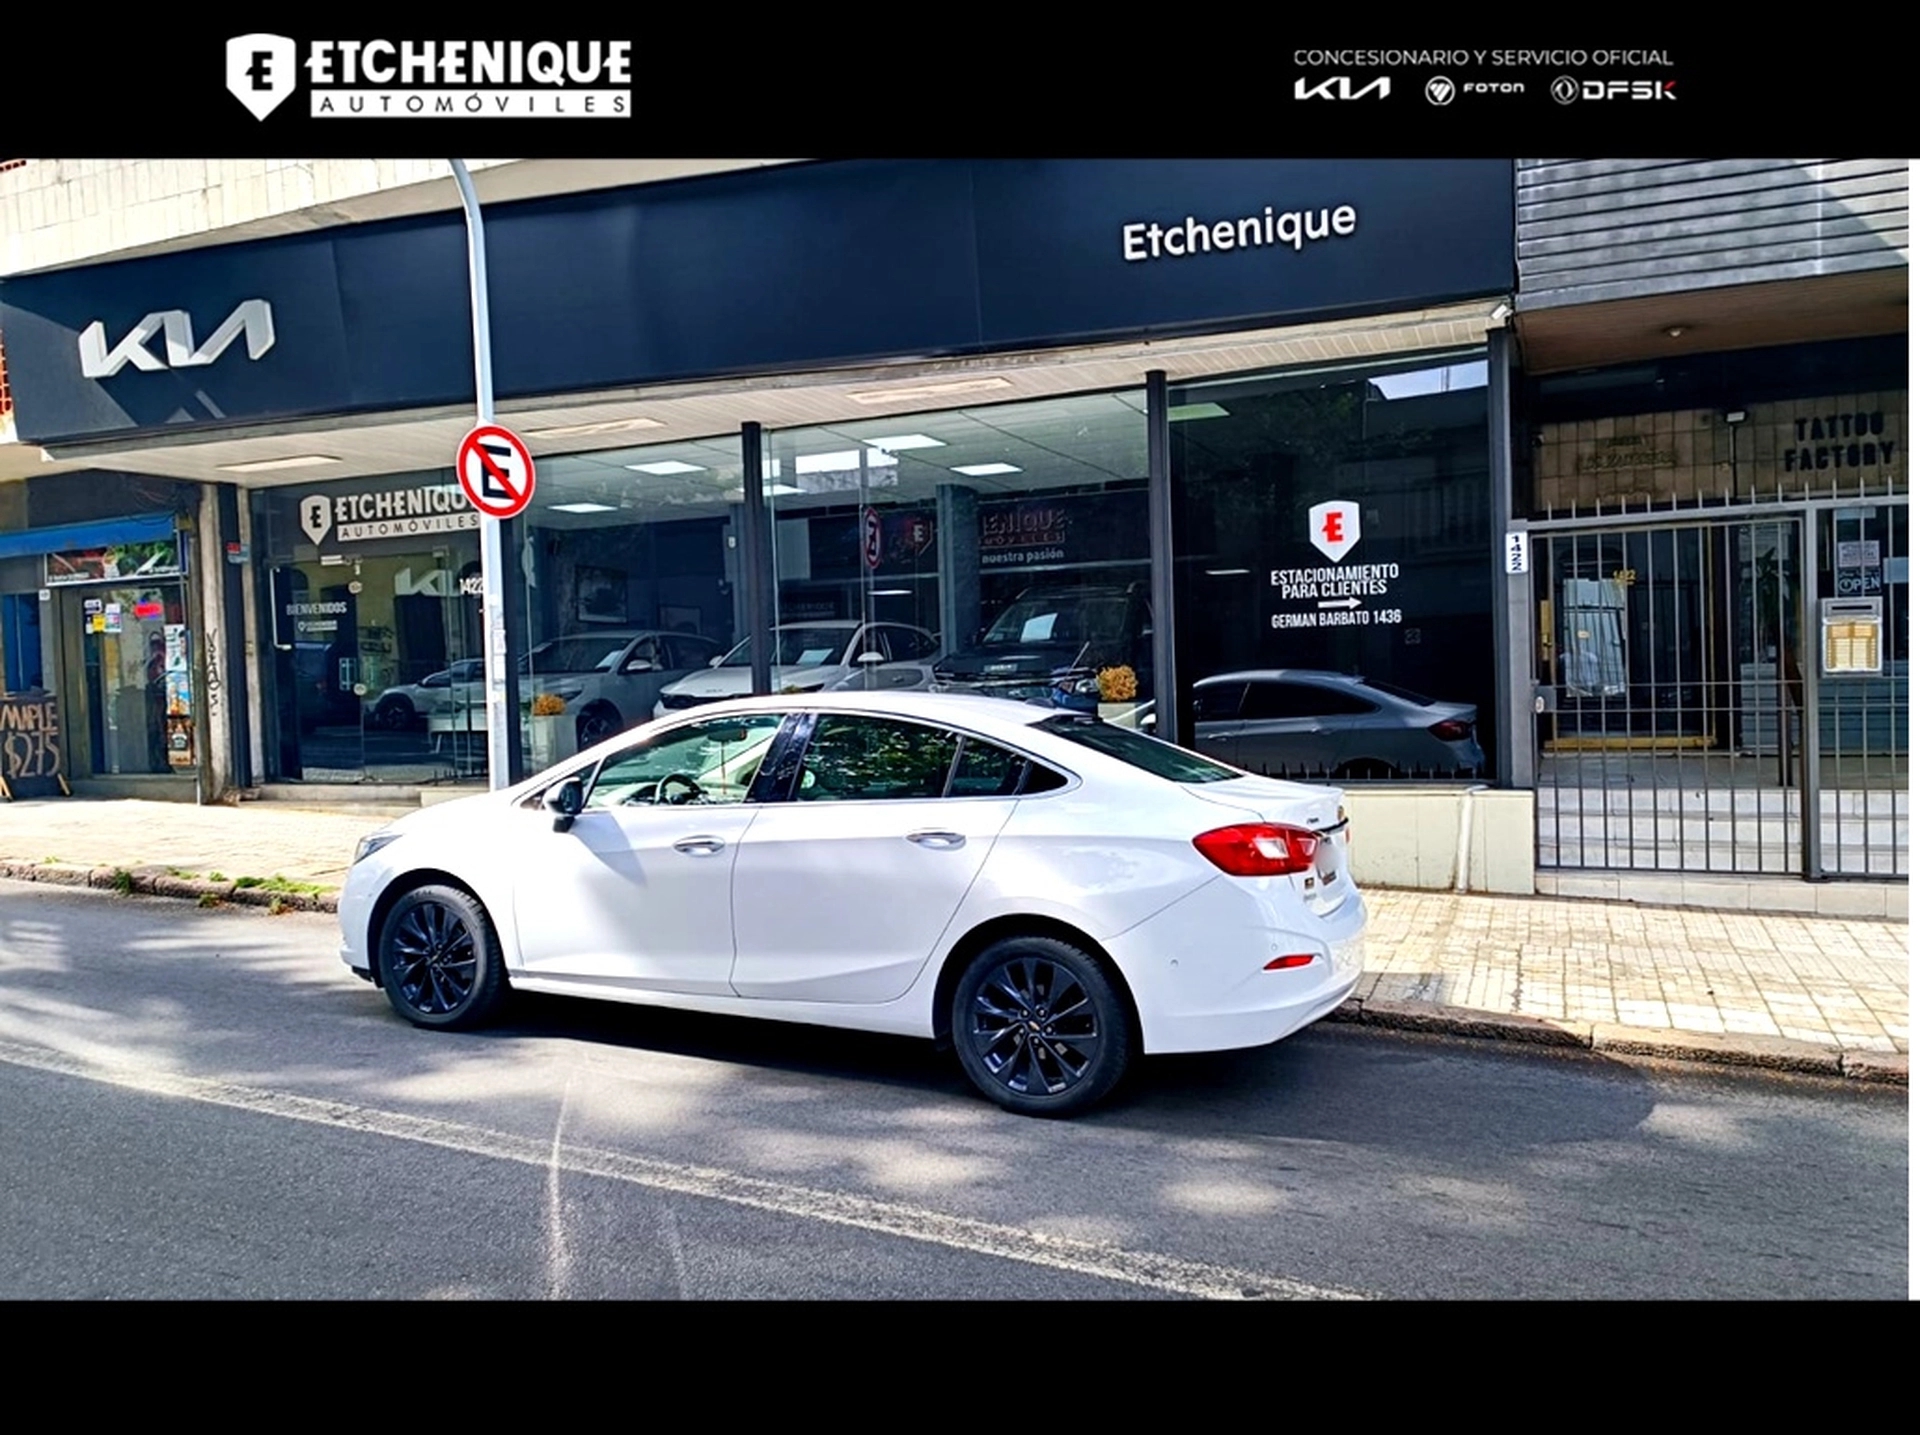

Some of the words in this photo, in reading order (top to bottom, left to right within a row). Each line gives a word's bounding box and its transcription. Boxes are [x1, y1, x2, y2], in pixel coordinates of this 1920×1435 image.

[1123, 204, 1357, 261] Etchenique
[78, 298, 275, 378] KIA
[1794, 411, 1884, 442] TATTOO
[1783, 441, 1894, 472] FACTORY
[335, 487, 476, 522] ETCHENIQU
[342, 514, 478, 538] AUTOMÓVILES
[1511, 535, 1522, 572] 1422
[1270, 563, 1400, 586] ESTACIONAMIENTO
[1282, 583, 1318, 599] PARA
[1321, 579, 1388, 597] CLIENTES
[1839, 576, 1880, 592] OPEN
[286, 602, 347, 615] BIENVENIDOS
[1271, 613, 1317, 628] GERMAN
[1319, 611, 1370, 626] BARBATO
[1373, 609, 1402, 624] 1436
[4, 731, 60, 779] $275
